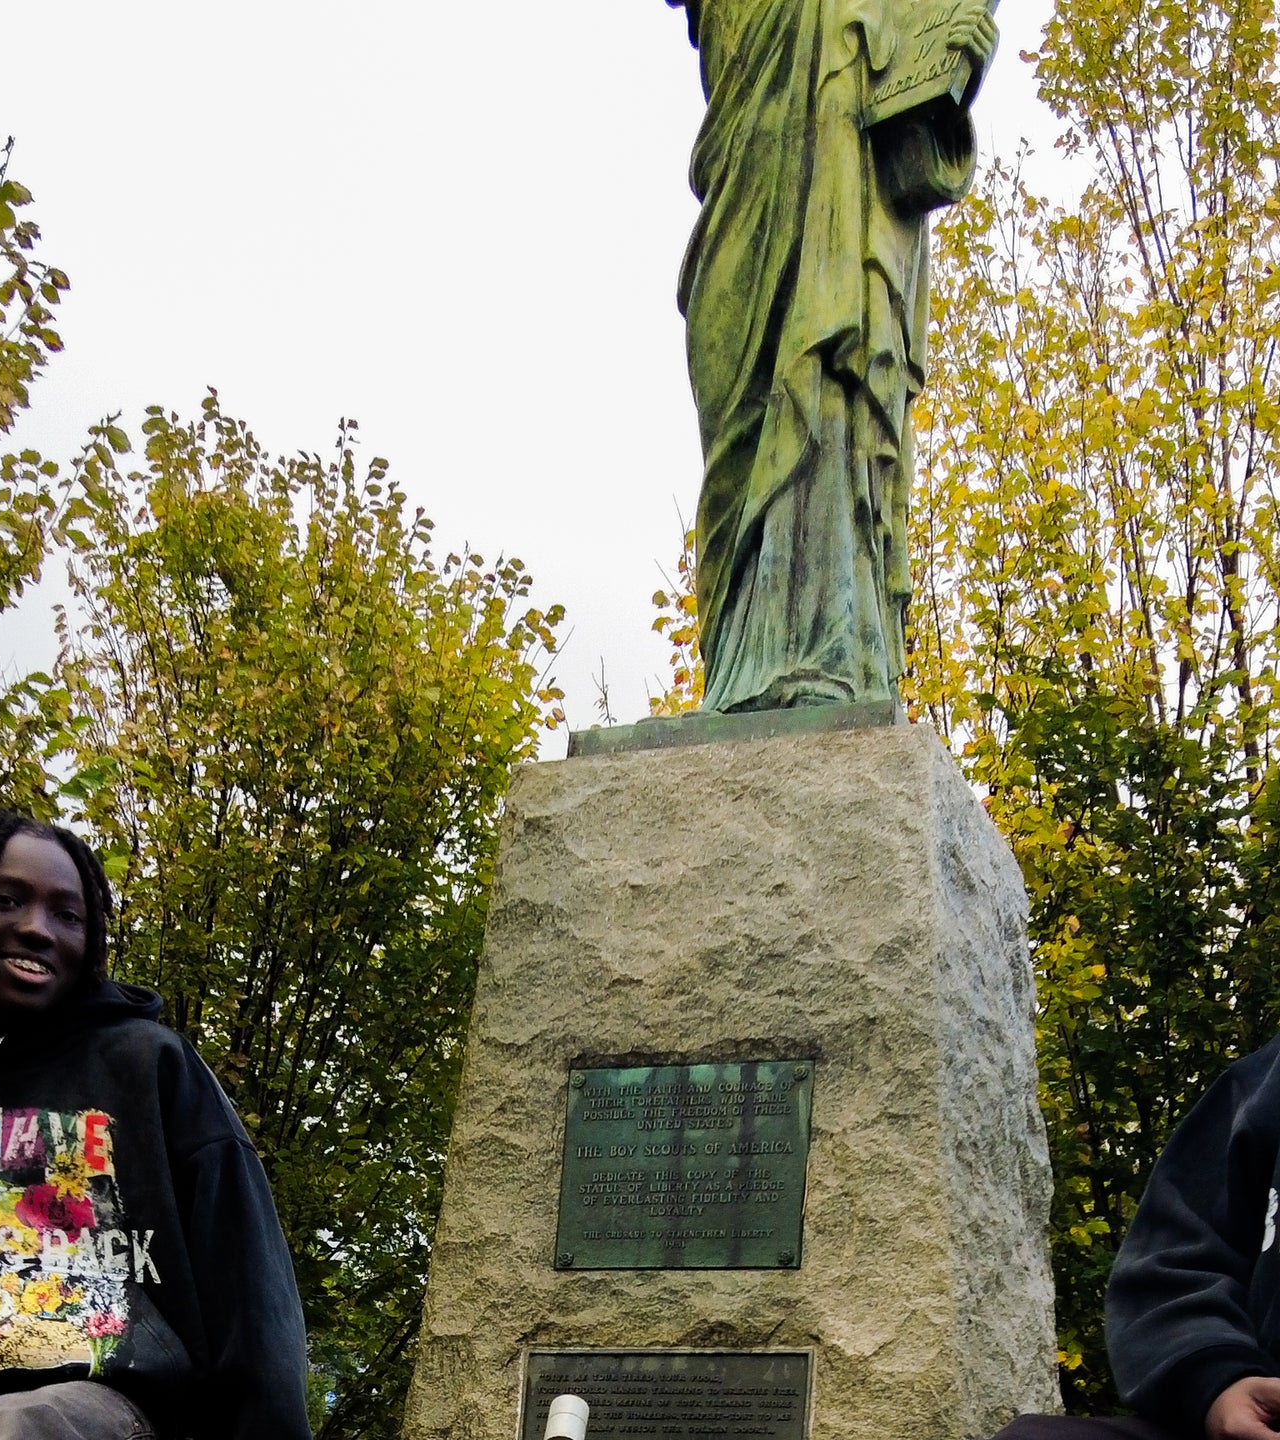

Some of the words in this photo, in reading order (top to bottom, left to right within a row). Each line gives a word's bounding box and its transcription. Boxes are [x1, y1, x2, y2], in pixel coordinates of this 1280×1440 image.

[583, 1087, 610, 1097] WITH
[620, 1085, 640, 1096] THE
[649, 1085, 681, 1095] FAITH
[688, 1084, 710, 1093] AND
[719, 1082, 772, 1092] COURAGE
[781, 1081, 794, 1091] OF
[590, 1098, 624, 1108] THEIR
[721, 1094, 745, 1104] WHO
[753, 1093, 786, 1103] MADE
[583, 1110, 635, 1120] POSSIBLE
[642, 1108, 665, 1118] THE
[672, 1106, 727, 1117] FREEDOM
[732, 1106, 745, 1115] OF
[754, 1104, 791, 1115] THESE
[638, 1119, 681, 1130] UNITED
[577, 1147, 602, 1158] THE
[610, 1146, 636, 1157] BOY
[644, 1144, 696, 1157] SCOUTS
[705, 1144, 722, 1154] OF
[728, 1141, 793, 1155] AMERICA
[593, 1171, 645, 1182] DEDICATE
[655, 1170, 679, 1180] THIS
[687, 1170, 717, 1180] COPY
[724, 1169, 739, 1178] OF
[748, 1168, 770, 1178] THE
[579, 1183, 621, 1193] STATUE
[627, 1182, 642, 1192] OF
[649, 1181, 700, 1192] LIBERTY
[706, 1181, 720, 1191] AS
[726, 1181, 733, 1191] A
[739, 1180, 784, 1191] PLEDGE
[583, 1195, 597, 1206] OF
[603, 1193, 685, 1205] EVERLASTING
[692, 1192, 750, 1203] FIDELITY
[756, 1192, 778, 1202] AND
[649, 1206, 704, 1217] LOYALTY
[583, 1230, 601, 1240] THE
[651, 1230, 662, 1238] TO
[732, 1229, 772, 1238] LIBERTY
